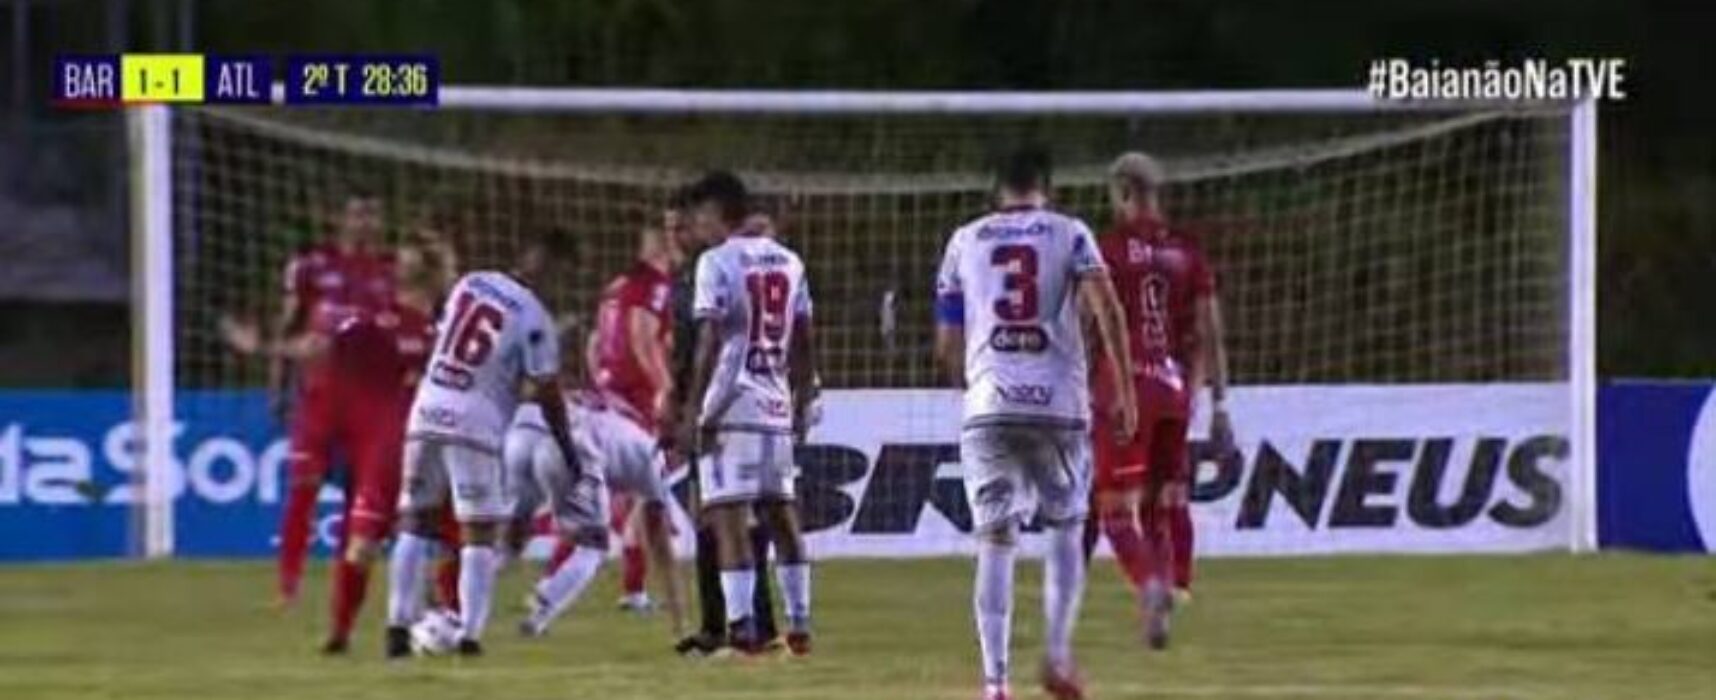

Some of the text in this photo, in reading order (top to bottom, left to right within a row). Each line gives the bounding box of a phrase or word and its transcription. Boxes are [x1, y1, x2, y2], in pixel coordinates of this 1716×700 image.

[746, 271, 788, 342] 19
[991, 245, 1038, 320] 3
[443, 291, 503, 367] 16
